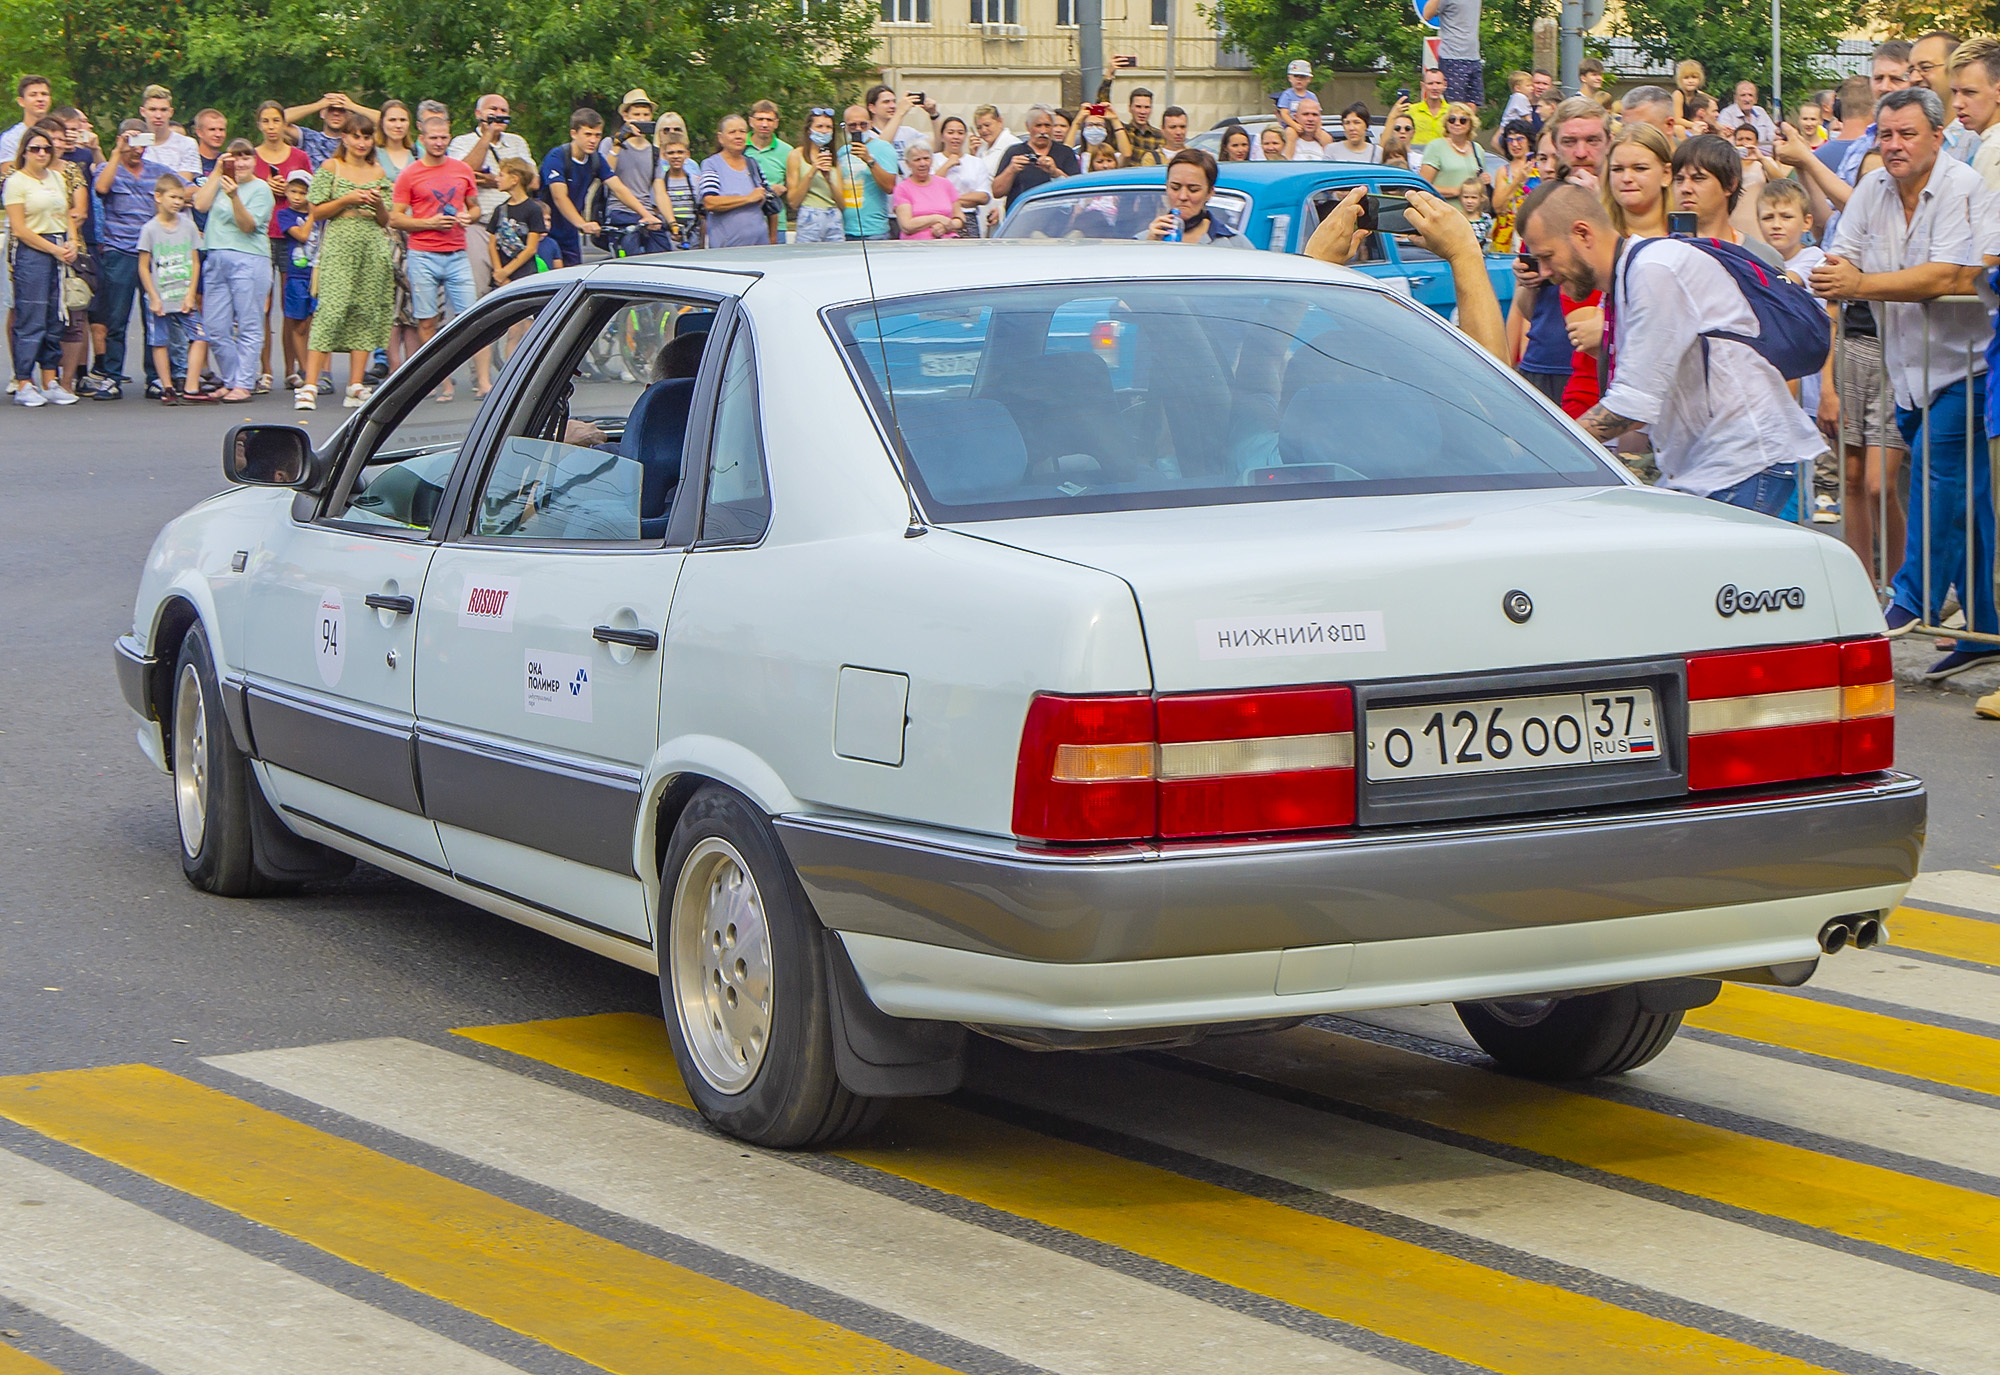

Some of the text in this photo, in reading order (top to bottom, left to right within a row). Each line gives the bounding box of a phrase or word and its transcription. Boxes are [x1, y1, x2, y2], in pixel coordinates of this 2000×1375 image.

[467, 587, 509, 618] ROSDOT
[322, 619, 337, 656] 94
[528, 661, 542, 676] ОКА
[528, 676, 560, 693] ПОЛИМЕР
[1592, 696, 1634, 737] 37
[1593, 739, 1628, 755] RUS
